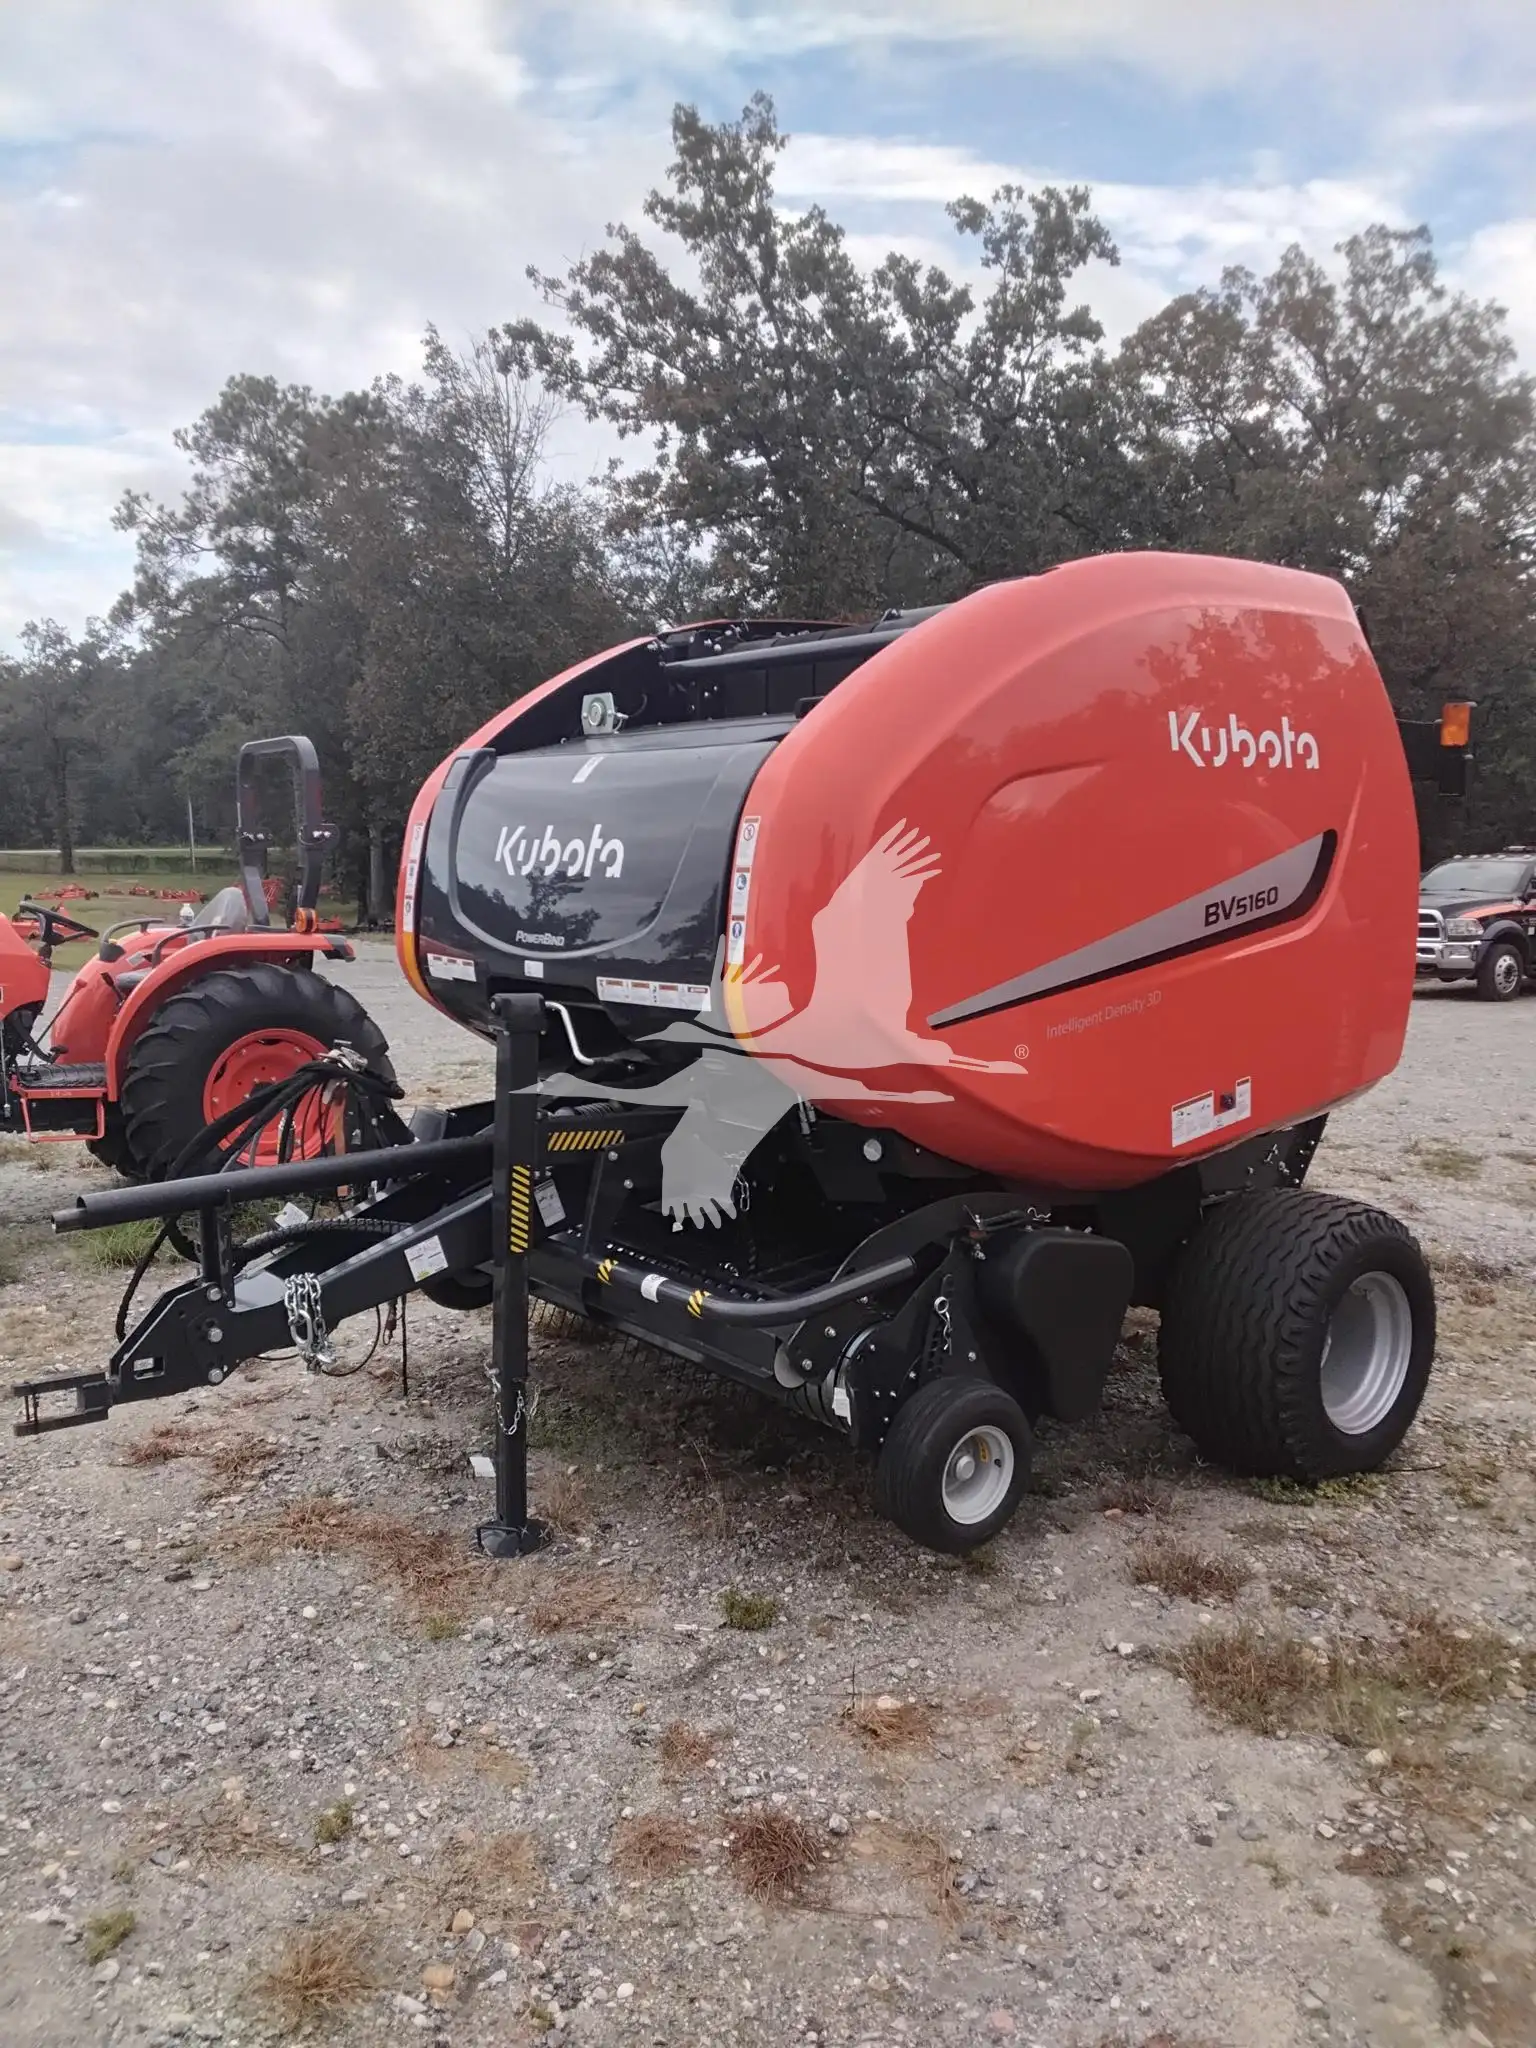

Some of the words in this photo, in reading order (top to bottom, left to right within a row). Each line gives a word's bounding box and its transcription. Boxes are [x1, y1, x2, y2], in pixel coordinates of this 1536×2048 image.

[1168, 711, 1320, 770] Kubota
[494, 823, 625, 878] Kubota
[1204, 886, 1279, 928] BV5160
[1046, 1012, 1102, 1039] Intelligent
[1105, 999, 1144, 1020] Density
[1147, 990, 1161, 1007] 3D
